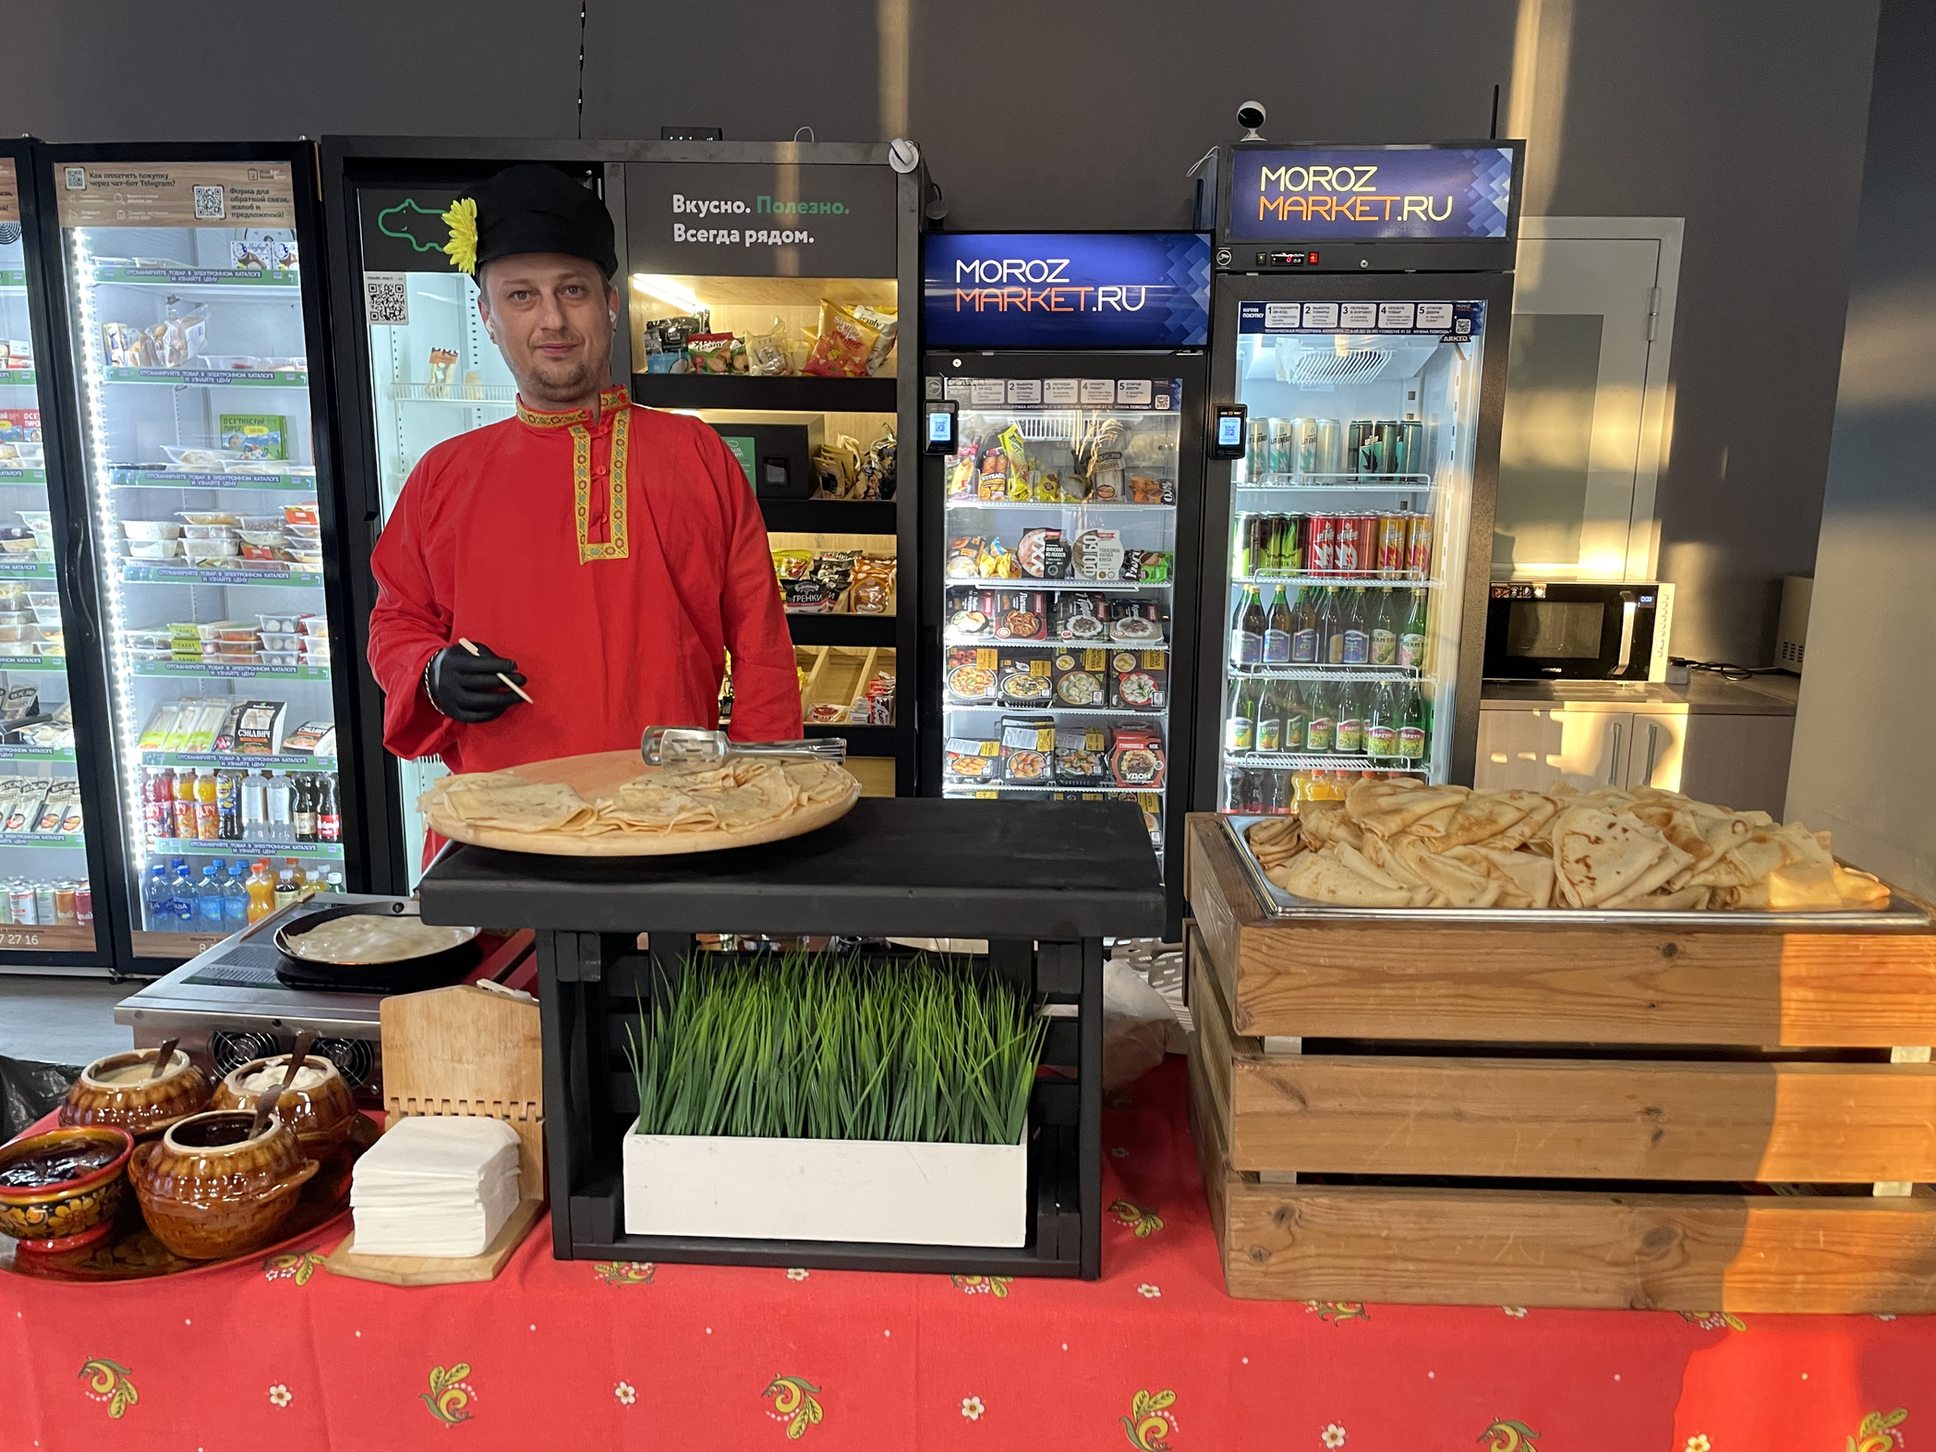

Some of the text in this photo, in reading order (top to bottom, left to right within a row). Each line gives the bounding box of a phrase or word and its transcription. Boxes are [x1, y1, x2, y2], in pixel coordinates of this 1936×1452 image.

[1260, 166, 1378, 192] MOROZ
[230, 188, 254, 196] Форма
[672, 194, 850, 218] Вкусно. Полезно.
[1258, 195, 1453, 222] MARKET.RU
[673, 223, 815, 247] Всегда рядом.
[956, 258, 1070, 283] MOROZ
[956, 286, 1146, 312] MARKET.RU
[1032, 533, 1046, 572] УХА
[793, 595, 822, 603] ГРЕНКИ
[8, 934, 21, 944] 27
[25, 934, 38, 945] 16
